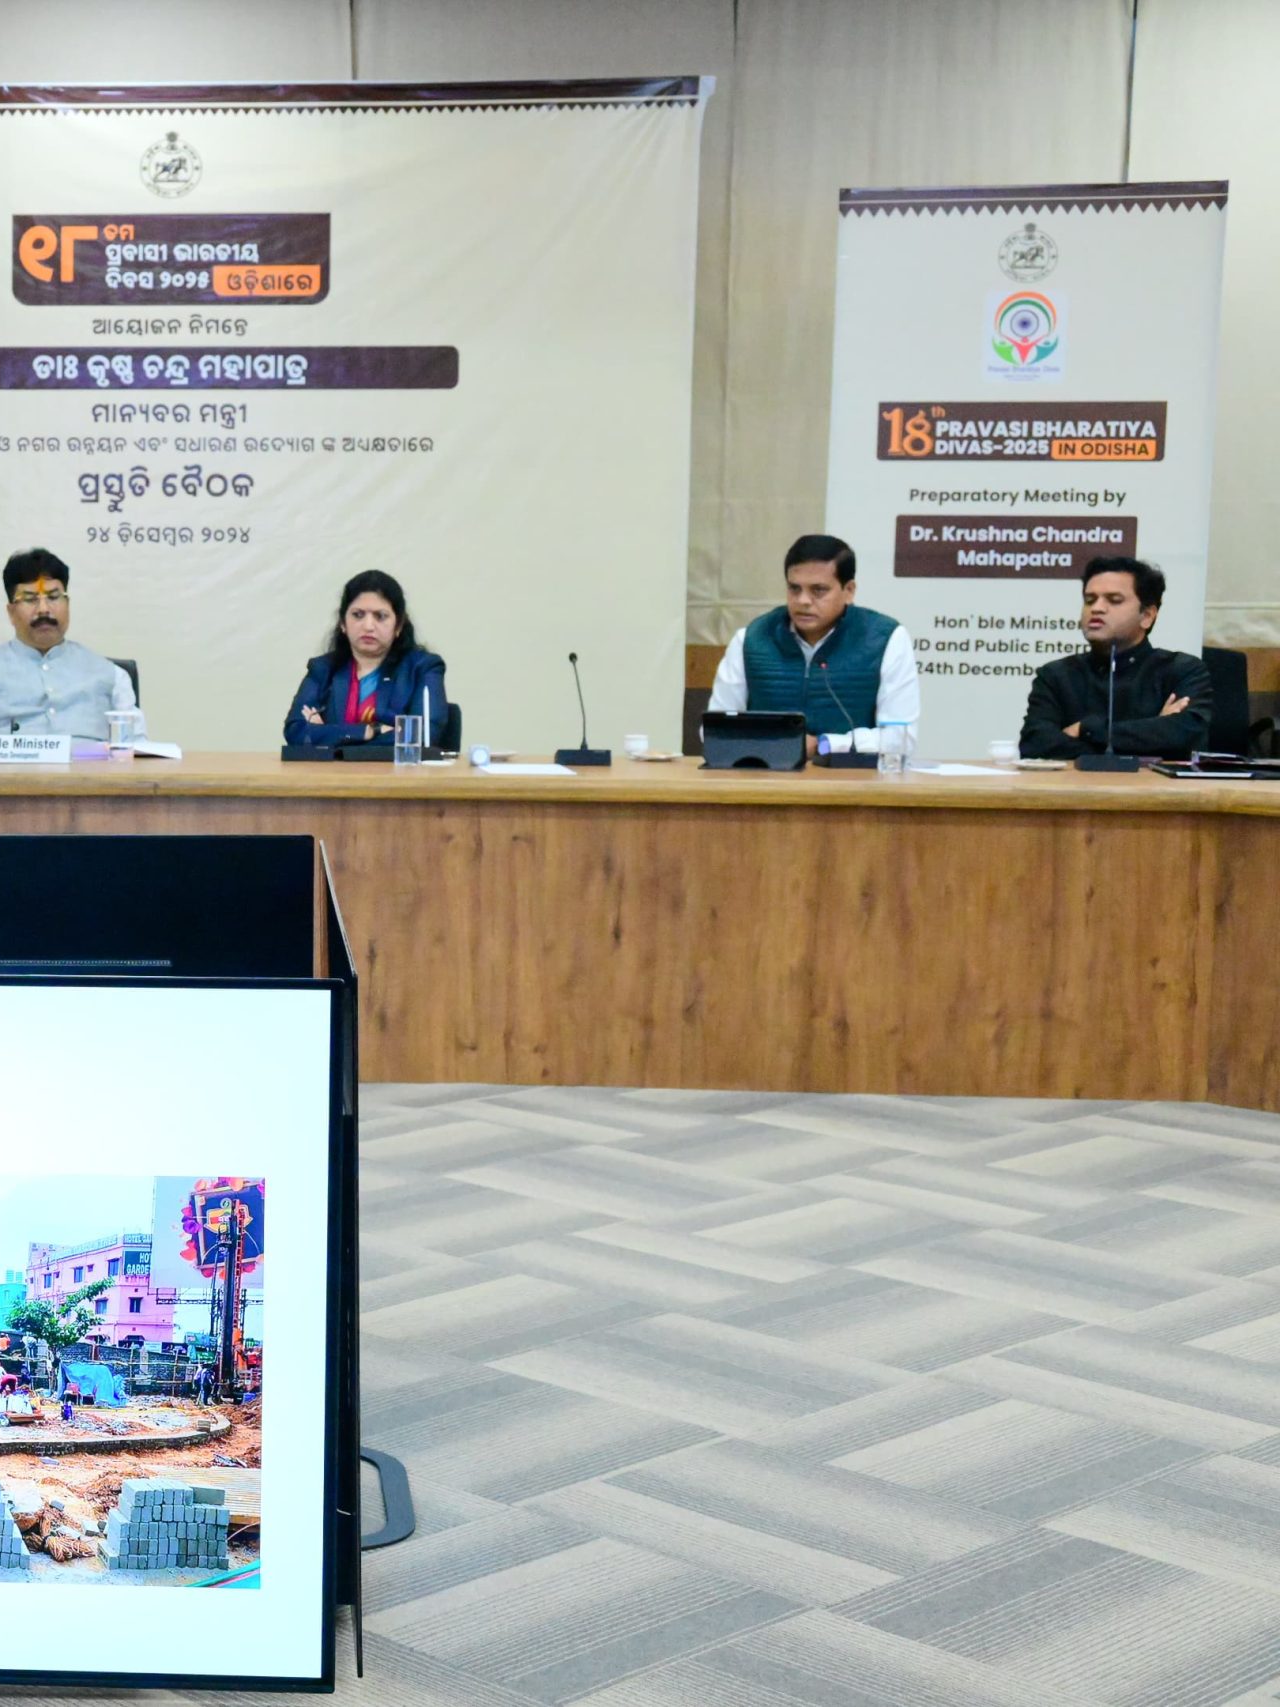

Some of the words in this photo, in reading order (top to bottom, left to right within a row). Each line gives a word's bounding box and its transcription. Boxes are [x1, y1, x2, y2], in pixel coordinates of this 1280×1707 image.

[105, 244, 168, 265] ପ୍ରବାସୀ
[173, 244, 259, 263] ଭାରତୀୟ
[105, 267, 153, 289] ଦିବସ
[160, 271, 210, 289] ୨୦୨୫
[227, 270, 313, 295] ଓଡ଼ିଶାରେ
[92, 318, 181, 336] ଆୟୋଜନ
[189, 313, 249, 336] ନିମନ୍ତେ
[32, 355, 79, 380] ଡାଃ
[87, 355, 134, 387] କୃଷ୍ଣ
[143, 355, 190, 385] ଚନ୍ଦ୍ର
[199, 355, 309, 385] ମହାପାତ୍ର
[92, 404, 191, 424] ମାନ୍ୟବର
[200, 404, 248, 430] ମନ୍ତ୍ରୀ
[936, 421, 1028, 437] PRAVASI
[1032, 421, 1157, 438] BHARATIYA
[17, 437, 61, 451] ନଗର
[133, 437, 168, 451] ଏବଂ
[935, 440, 1050, 455] DIVAS-2025
[1058, 443, 1078, 455] IN
[1081, 442, 1149, 456] ODISHA
[78, 466, 150, 513] ପ୍ରସ୍ତୁତି
[161, 465, 254, 498] ବୈଠକ
[910, 488, 1019, 507] Preparatory
[1024, 488, 1099, 507] Meeting
[1103, 490, 1127, 507] by
[86, 527, 110, 543] ୨୪
[201, 527, 251, 543] ୨୦୨୪
[910, 525, 939, 542] Dr.
[942, 525, 1028, 543] Krushna
[1032, 525, 1123, 543] Chandra
[957, 550, 1072, 571] Mahapatra
[935, 638, 969, 651] and
[975, 639, 1030, 653] Public
[14, 738, 61, 749] Minister
